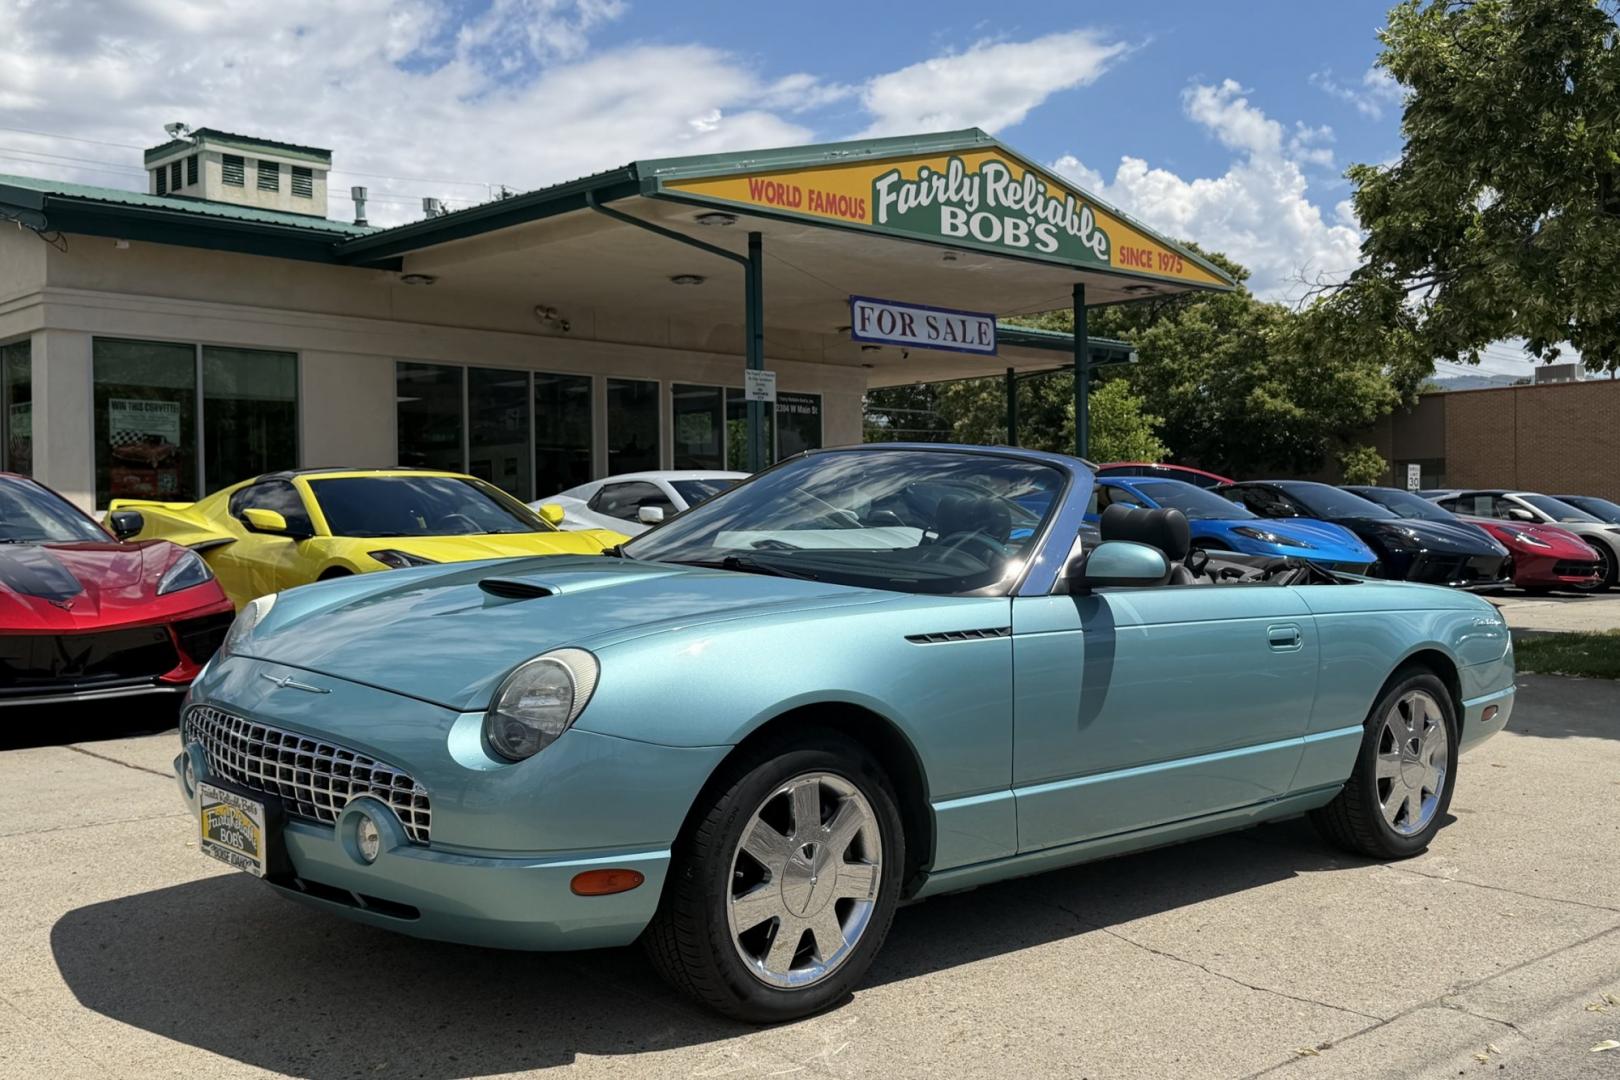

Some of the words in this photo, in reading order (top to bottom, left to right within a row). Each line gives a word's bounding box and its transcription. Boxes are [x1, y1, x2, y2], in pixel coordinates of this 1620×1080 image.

[748, 176, 802, 208] WORLD
[808, 190, 866, 220] FAMOUS
[876, 159, 979, 223] Fairly
[982, 163, 1108, 260] Reliable
[940, 205, 1059, 253] BOB'S
[1119, 246, 1153, 268] SINCE
[1158, 252, 1183, 273] 1975
[858, 306, 917, 337] FOR
[926, 315, 992, 346] SALE
[111, 400, 126, 410] WIN
[790, 405, 797, 413] W
[797, 406, 810, 414] Main
[1409, 477, 1419, 487] 30
